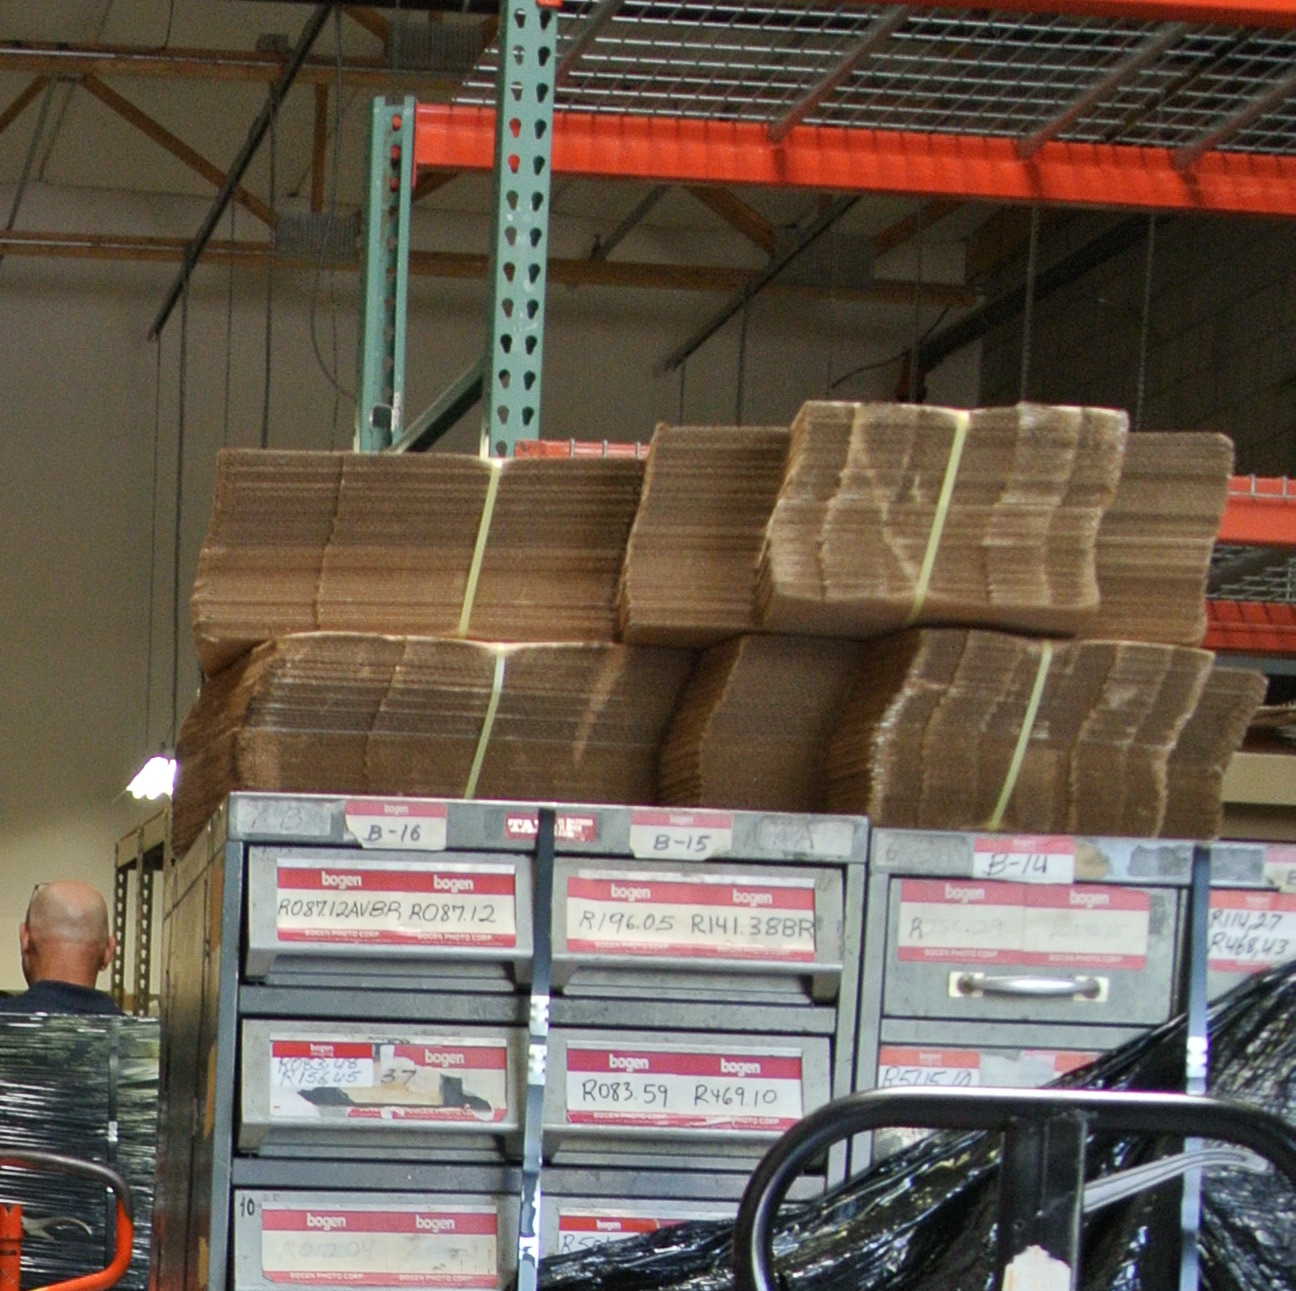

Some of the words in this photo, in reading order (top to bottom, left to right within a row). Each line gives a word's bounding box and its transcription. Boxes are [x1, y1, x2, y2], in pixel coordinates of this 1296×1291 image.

[363, 824, 421, 842] B-16
[653, 834, 711, 851] B-15
[984, 852, 1049, 876] B-14
[321, 871, 362, 888] bogen
[433, 874, 474, 892] bogen
[610, 883, 651, 901] bogen
[732, 888, 773, 907] bogen
[945, 883, 985, 904] bogen
[1069, 890, 1110, 908] bogen
[409, 902, 496, 923] R087.12
[579, 910, 675, 932] R196.05
[424, 1049, 465, 1067] bogen
[609, 1053, 649, 1072] bogen
[720, 1058, 761, 1077] bogen
[582, 1079, 668, 1108] R083.59
[694, 1084, 777, 1107] R469.10
[240, 1196, 255, 1218] 10
[306, 1212, 346, 1231] bogen
[415, 1214, 455, 1233] bogen
[317, 1272, 342, 1280] PHOTO
